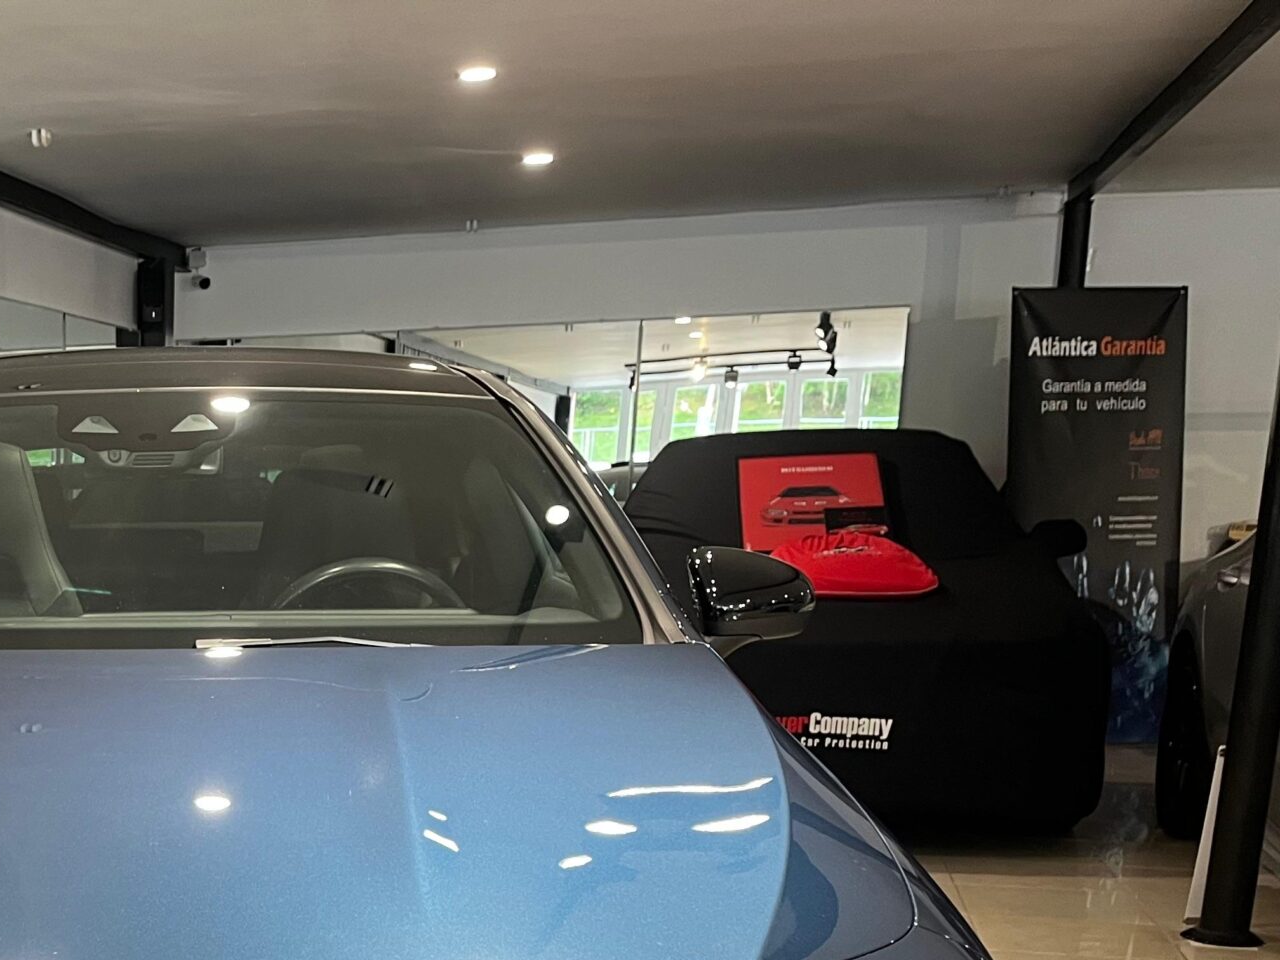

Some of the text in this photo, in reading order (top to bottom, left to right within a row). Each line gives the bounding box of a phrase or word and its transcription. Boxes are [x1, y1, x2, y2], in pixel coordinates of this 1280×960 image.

[1028, 336, 1097, 356] Atlántica
[1094, 381, 1101, 392] a
[1104, 379, 1147, 393] medida
[1041, 399, 1068, 414] para
[1076, 397, 1088, 411] tu
[800, 736, 889, 750] Car Protection
